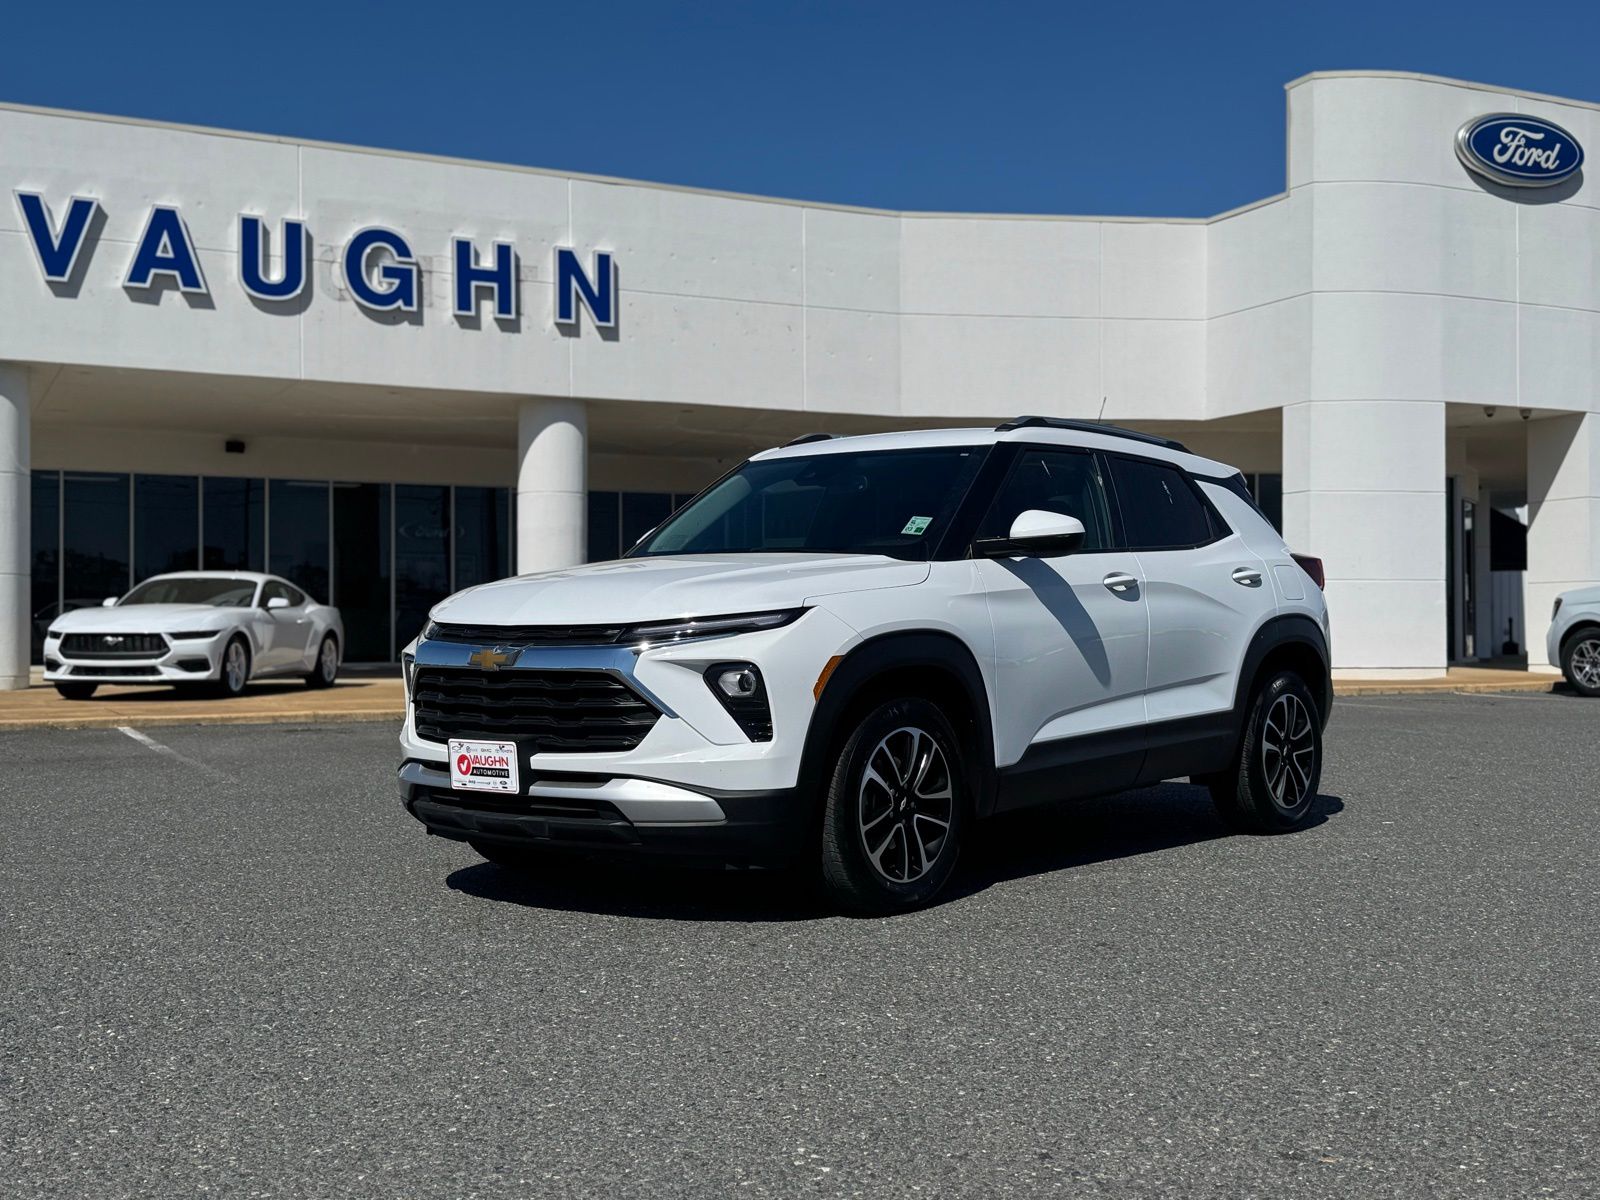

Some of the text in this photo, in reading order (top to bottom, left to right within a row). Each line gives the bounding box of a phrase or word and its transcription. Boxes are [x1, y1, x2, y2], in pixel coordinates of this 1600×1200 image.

[1493, 126, 1561, 170] Ford
[13, 189, 614, 327] VAUGHN
[469, 754, 509, 767] VAUGHN
[472, 768, 509, 777] AUTOMOTIVE
